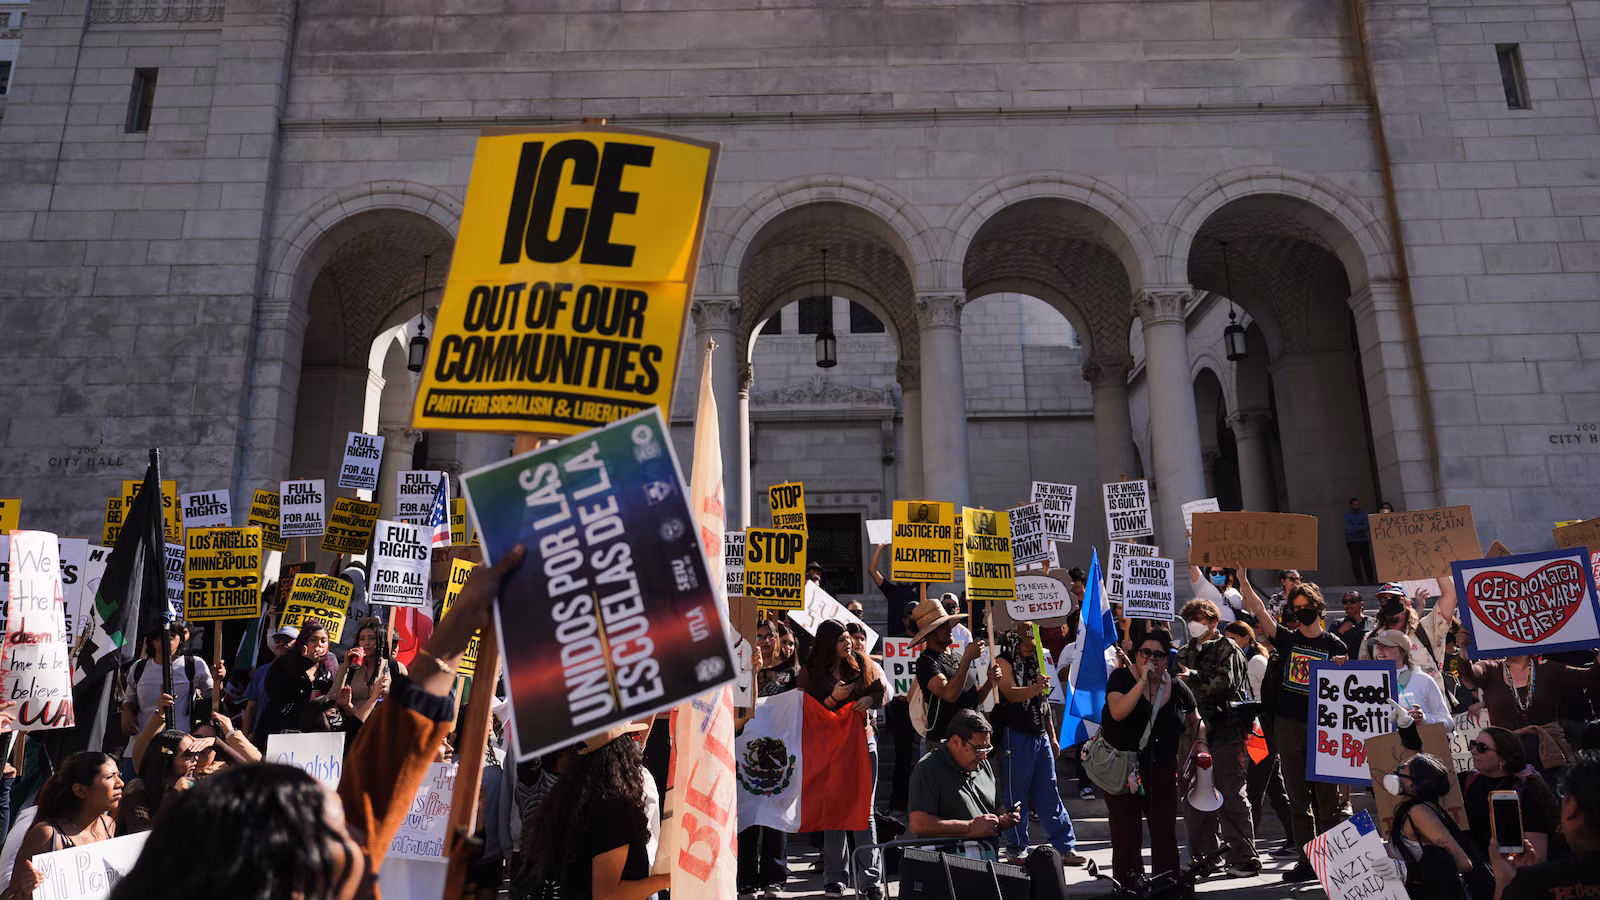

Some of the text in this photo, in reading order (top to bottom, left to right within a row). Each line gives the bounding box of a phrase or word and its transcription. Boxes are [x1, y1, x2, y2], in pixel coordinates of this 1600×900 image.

[499, 138, 655, 268] ICE
[463, 281, 649, 340] OUT OF OUR
[433, 333, 663, 396] COMMUNITIES
[427, 395, 465, 411] PARTY
[465, 395, 489, 412] FOR
[489, 395, 553, 416] SOCIALISM
[554, 399, 571, 417] &
[353, 436, 375, 448] FULL
[1549, 434, 1582, 444] CITY
[347, 447, 380, 460] RIGHTS
[48, 457, 124, 467] CITY HALL
[344, 464, 375, 476] FOR ALL
[342, 473, 375, 483] IMMIGRANTS
[406, 473, 431, 485] FULL
[288, 483, 315, 494] FULL
[400, 484, 438, 495] RIGHTS
[1037, 483, 1072, 496] THE WHOLE
[1107, 482, 1144, 494] THE WHOLE
[190, 494, 220, 507] FULL
[283, 494, 322, 505] RIGHTS
[771, 485, 802, 510] STOP
[1035, 493, 1073, 501] SYSTEM
[1109, 496, 1145, 510] IS GUILTY
[185, 504, 228, 518] RIGHTS
[335, 500, 378, 517] LOS ANGELES
[400, 503, 418, 512] FOR
[1016, 504, 1040, 519] WHOLE
[1044, 500, 1071, 512] GUILTY
[284, 512, 321, 523] FOR ALL
[331, 513, 374, 528] MINNEAPOLIS
[577, 495, 626, 546] DE
[774, 513, 804, 525] ICE TERROR
[1109, 510, 1136, 518] SHUT
[1379, 510, 1455, 529] MAKE ORWELL
[283, 521, 322, 530] IMMIGRANTS
[1014, 520, 1041, 536] GUILTY
[1113, 516, 1147, 531] DOWN!
[1374, 517, 1464, 540] FICTION AGAIN
[327, 526, 370, 538] STOP
[387, 525, 420, 546] FULL
[895, 524, 951, 539] JUSTICE FOR
[1203, 520, 1229, 543] ICE
[1232, 521, 1271, 541] OUT
[190, 534, 258, 550] LOS ANGELES
[324, 533, 337, 545] ICE
[338, 535, 366, 549] TERROR
[748, 532, 803, 564] STOP
[966, 535, 1009, 552] JUSTICE FOR
[15, 539, 51, 573] We
[378, 541, 428, 560] RIGHTS
[895, 548, 951, 563] ALEX PRETTI
[1115, 544, 1128, 554] THE
[189, 556, 258, 570] MINNEAPOLIS
[967, 561, 1012, 579] ALEX PRETTI
[1113, 559, 1121, 570] IS
[1141, 560, 1170, 569] PUEBLO
[376, 569, 424, 586] FOR ALL
[672, 559, 691, 592] SEIU
[746, 571, 801, 587] ICE TERROR
[1131, 568, 1167, 580] UNIDO
[188, 576, 258, 590] STOP
[296, 577, 350, 596] LOS ANGELES
[373, 583, 423, 597] IMMIGRANTS
[1028, 583, 1048, 591] NEVER
[1474, 577, 1503, 599] ICE
[1521, 577, 1539, 597] NO
[13, 579, 48, 612] the
[188, 589, 257, 608] ICE TERROR
[519, 462, 616, 727] UNIDOS POR LAS
[746, 587, 801, 598] NOW!
[1038, 592, 1059, 600] JUST
[1126, 590, 1172, 601] A LAS FAMILIAS
[291, 591, 346, 610] MINNEAPOLIS
[1014, 600, 1064, 613] TO EXIST!
[1128, 599, 1170, 610] INMIGRANTES
[1477, 582, 1581, 627] FOR OUR WARM
[283, 613, 300, 625] ICE
[287, 604, 343, 619] STOP
[10, 617, 52, 644] dream
[590, 541, 666, 710] ESCUELAS
[686, 606, 709, 643] UTLA
[1505, 608, 1564, 641] HEARTS
[11, 650, 32, 671] have
[38, 654, 47, 670] to
[11, 676, 59, 699] believe
[1319, 674, 1390, 705] Be Good
[1318, 704, 1389, 733] Be Pretti
[1318, 730, 1339, 756] Be
[1314, 826, 1359, 867] MAKE
[38, 856, 68, 900] Mi
